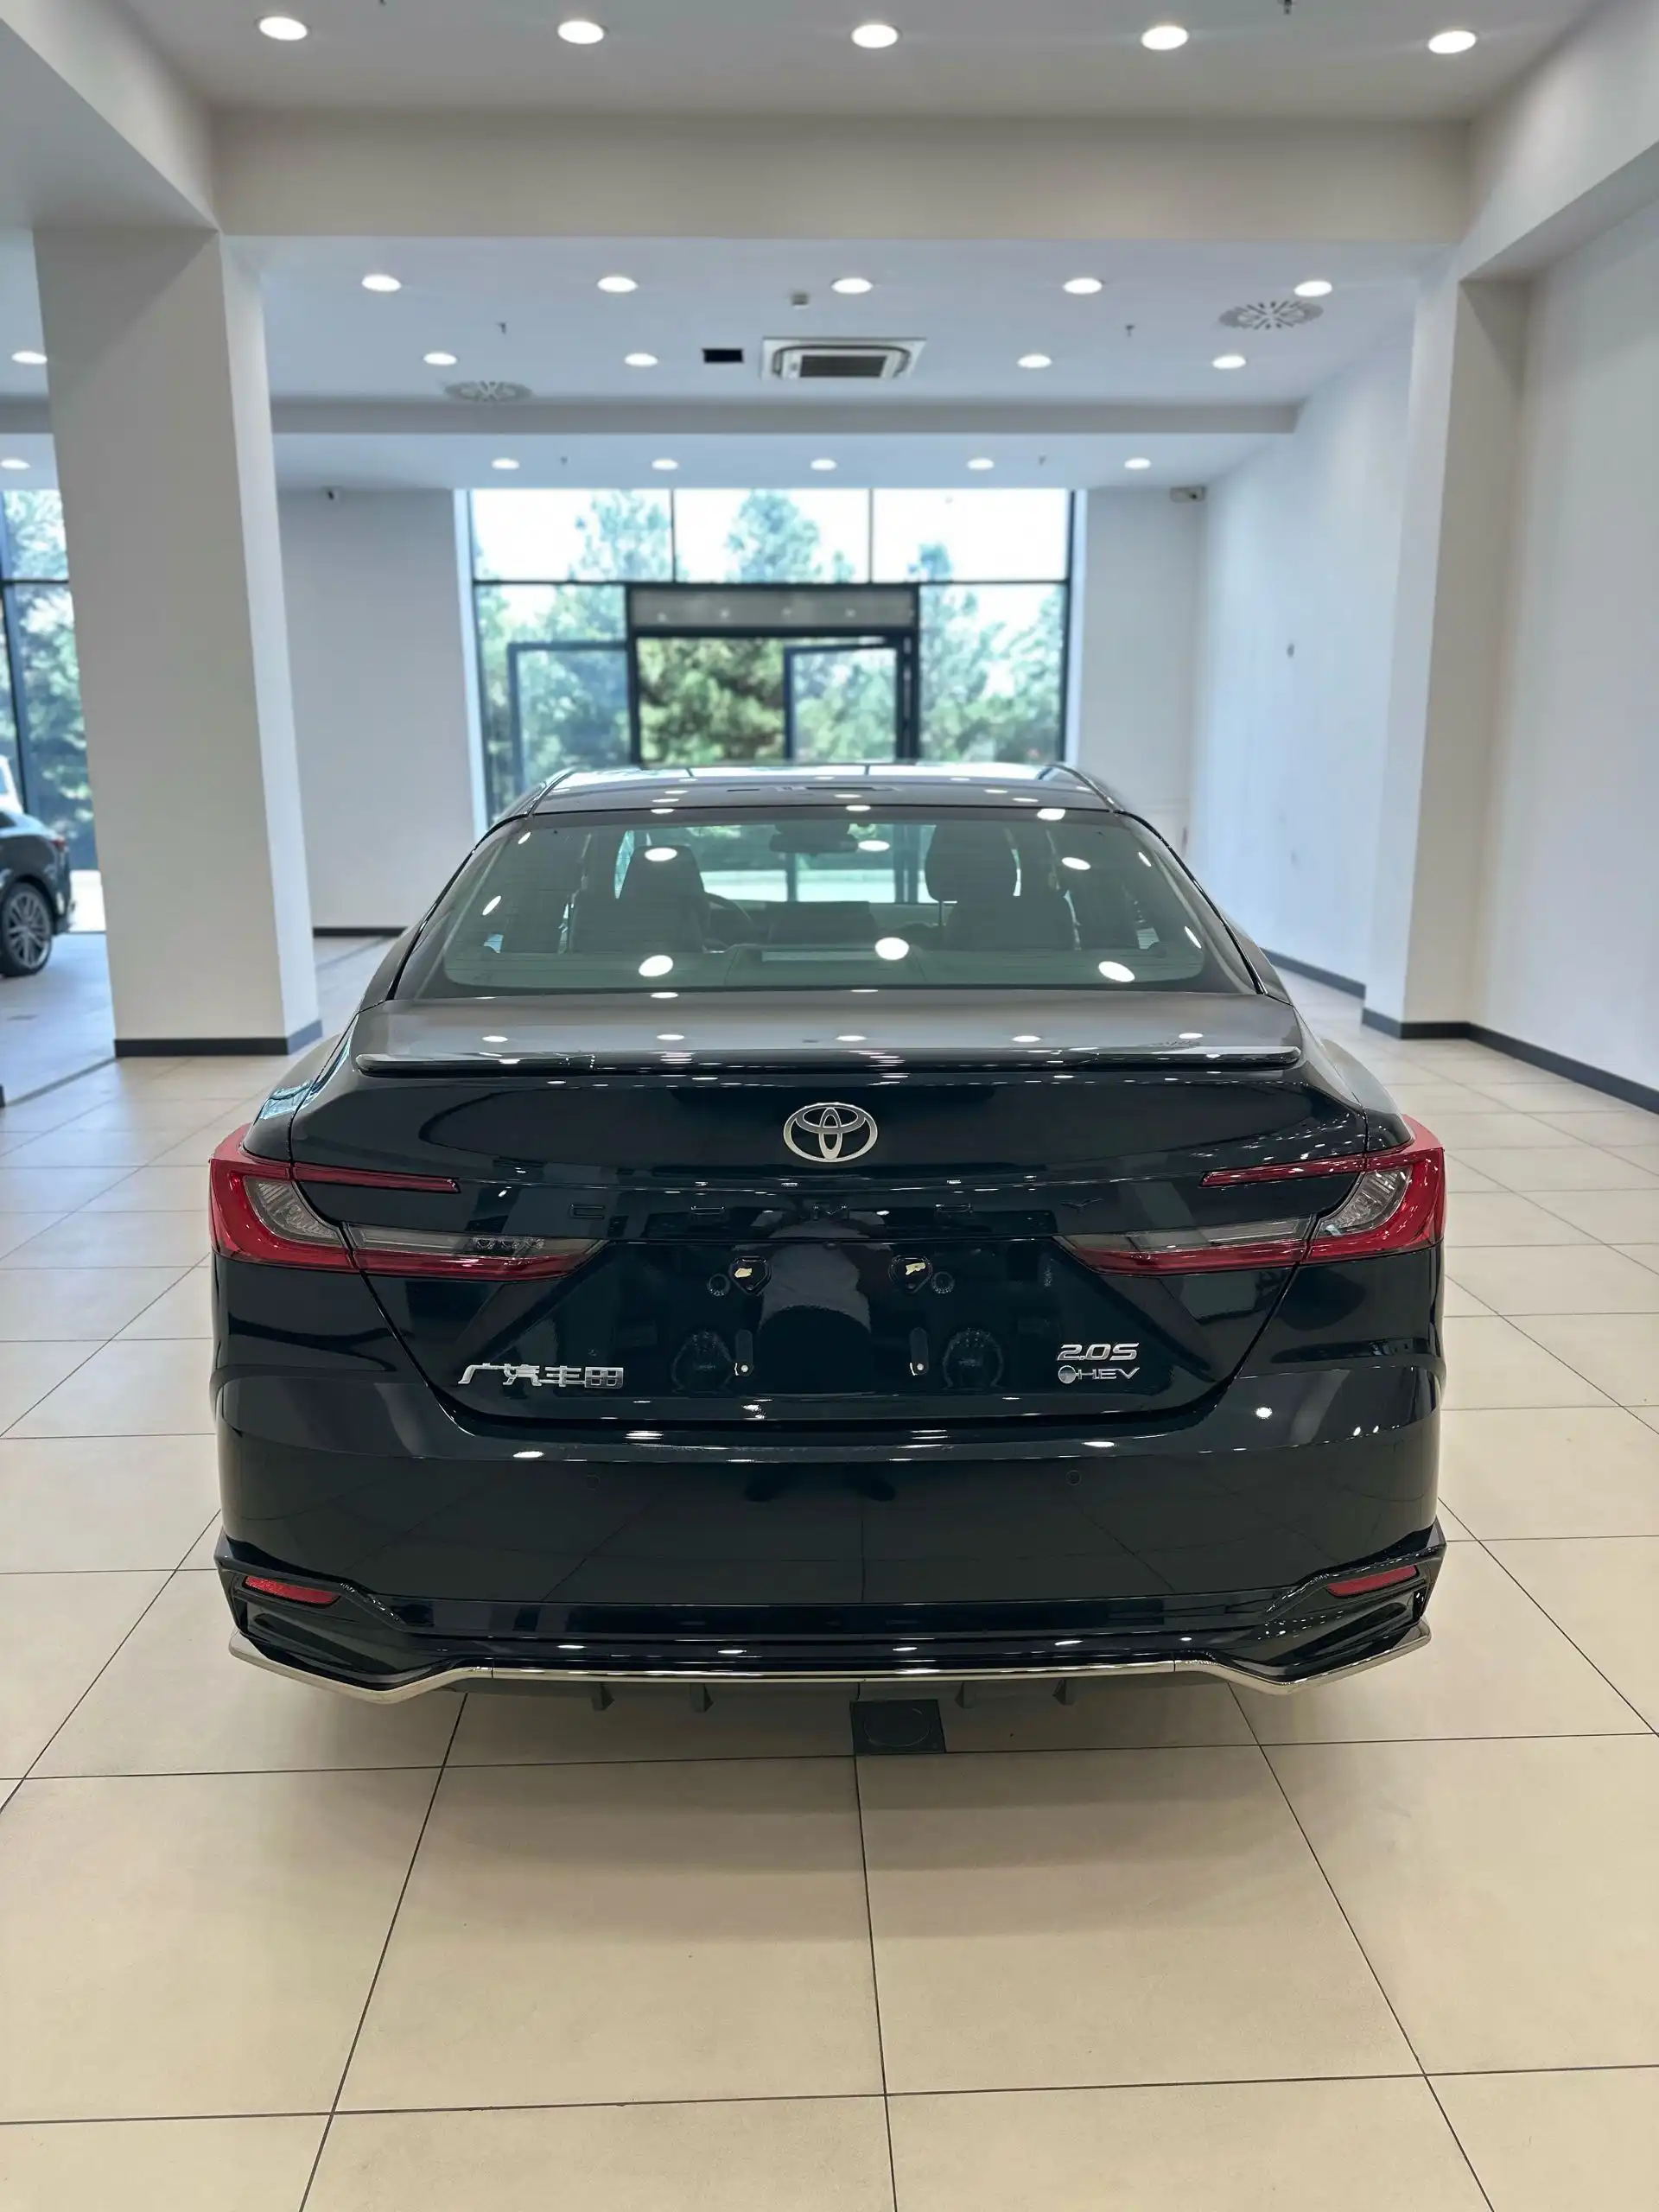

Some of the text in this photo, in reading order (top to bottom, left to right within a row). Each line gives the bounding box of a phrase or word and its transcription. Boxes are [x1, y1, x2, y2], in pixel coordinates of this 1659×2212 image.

[1057, 1342, 1140, 1361] 2.0S
[458, 1363, 624, 1389] 广汽丰田
[1076, 1366, 1141, 1381] HEV
